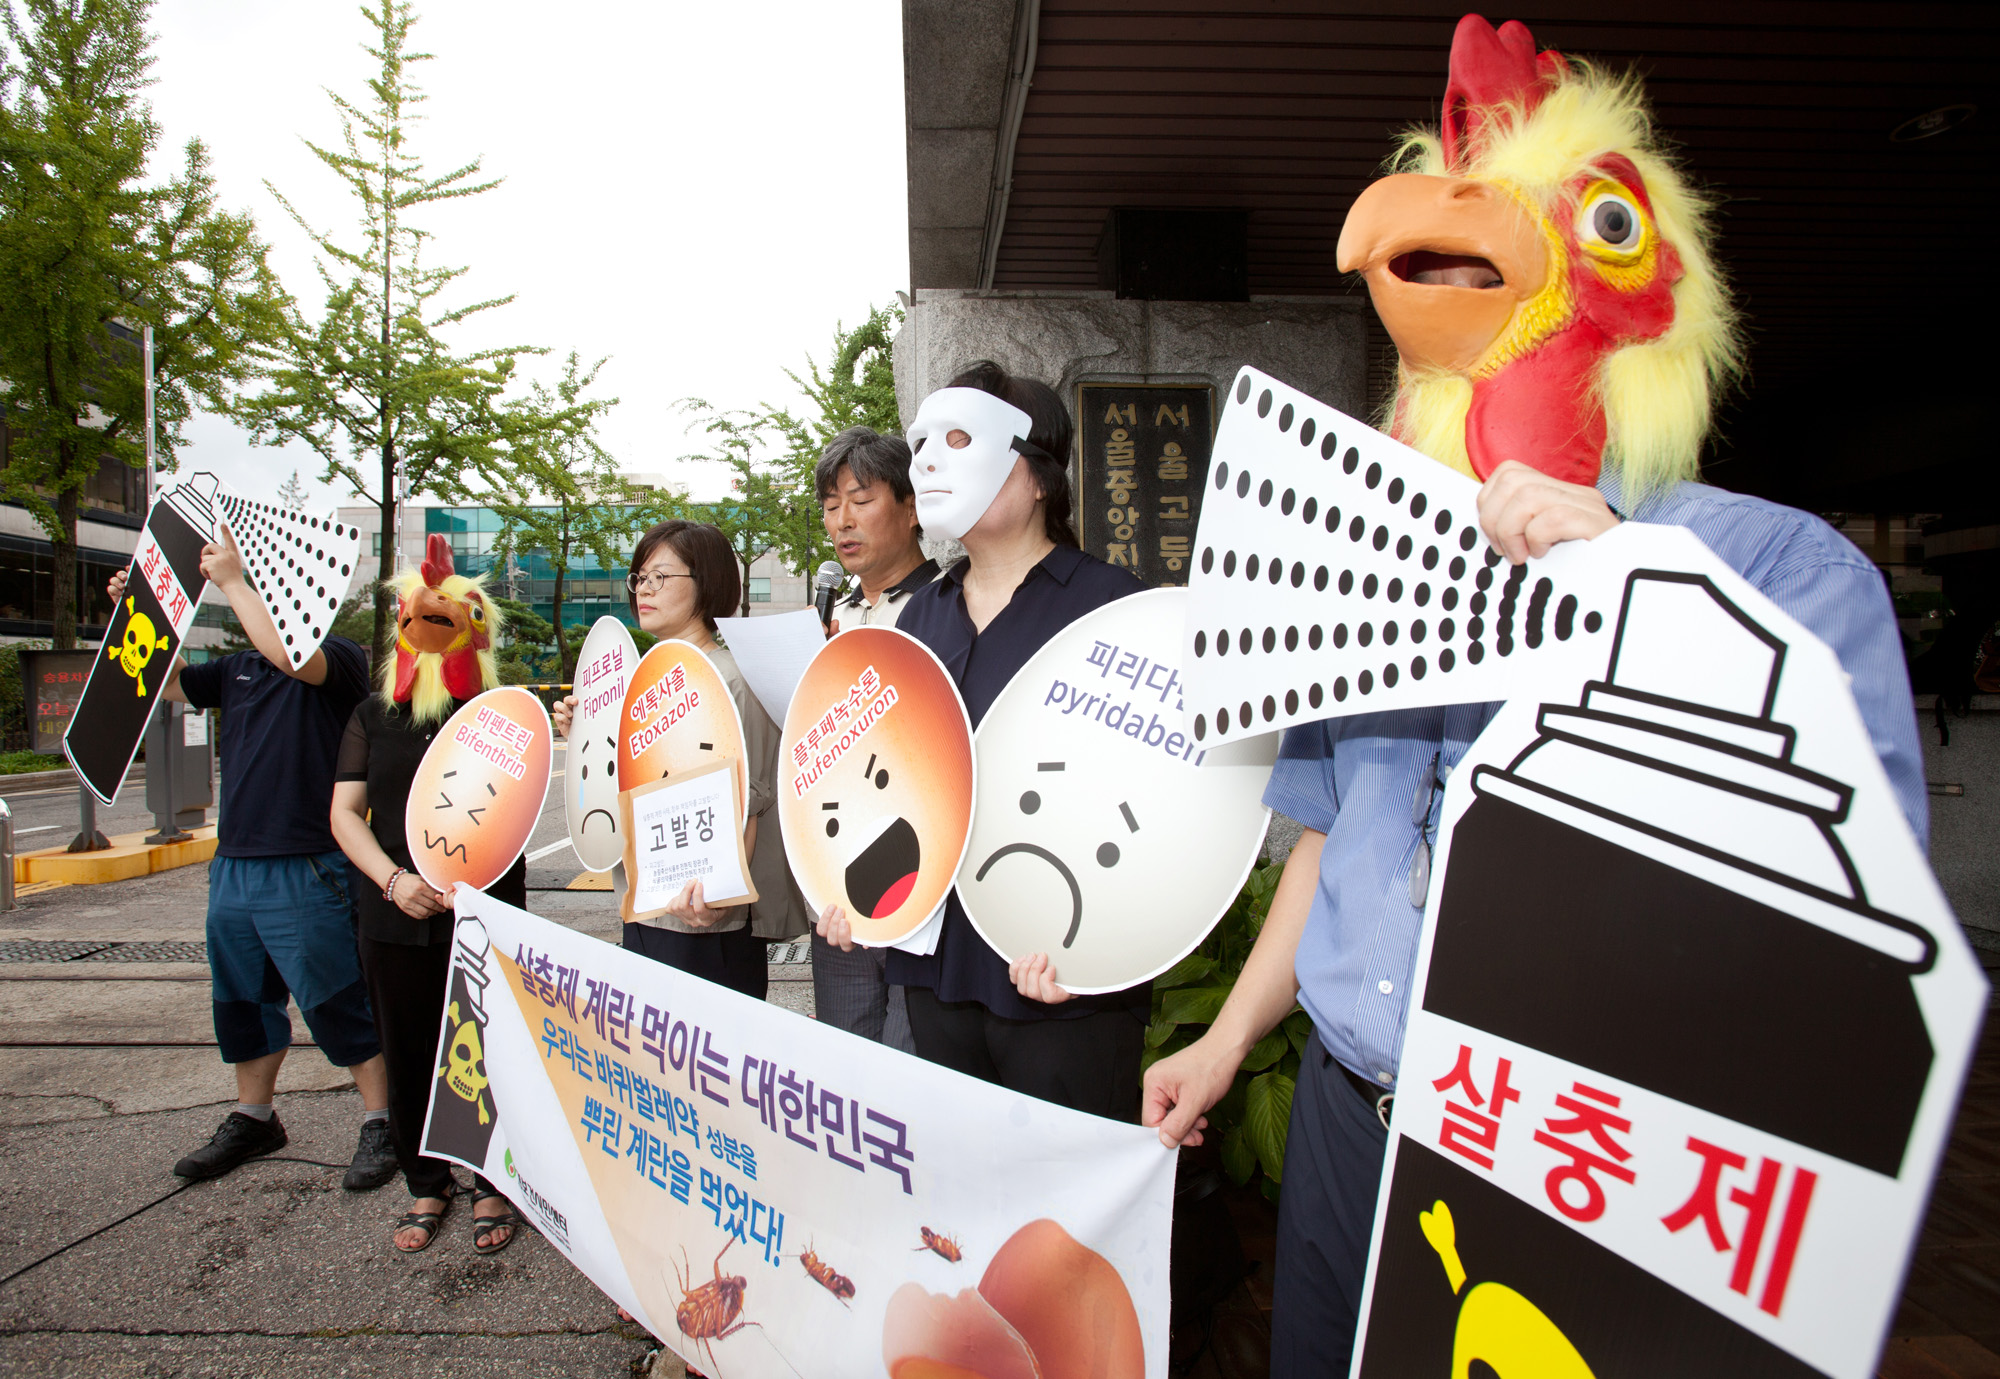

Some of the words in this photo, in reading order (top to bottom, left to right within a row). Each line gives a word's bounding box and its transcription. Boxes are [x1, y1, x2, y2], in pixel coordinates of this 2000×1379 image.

[1104, 403, 1140, 580] 서울중앙지
[1155, 404, 1190, 587] 서울고등
[143, 543, 187, 627] 살충제
[582, 644, 624, 688] 피프로닐
[583, 675, 625, 720] Fipronil
[632, 664, 685, 721] 에톡사졸
[1086, 640, 1184, 711] 피리다
[455, 724, 525, 778] Bifenthrin
[477, 707, 532, 752] 비펜트린
[631, 691, 700, 757] Etoxazole
[793, 669, 878, 767] 플루페녹수론
[794, 688, 896, 796] Flufenoxuron
[650, 806, 715, 852] 고발장
[514, 943, 580, 1024] 살충제
[582, 978, 635, 1055] 계란
[641, 1004, 730, 1108] 먹이는
[741, 1054, 914, 1195] 대한민국
[541, 1017, 593, 1082] 우리는
[594, 1049, 700, 1150] 바퀴벌레약
[706, 1125, 758, 1181] 성분을
[580, 1095, 622, 1160] 뿌린
[626, 1122, 693, 1206] 계란을
[700, 1166, 785, 1267] 먹었다!
[1431, 1044, 1818, 1319] 살충제
